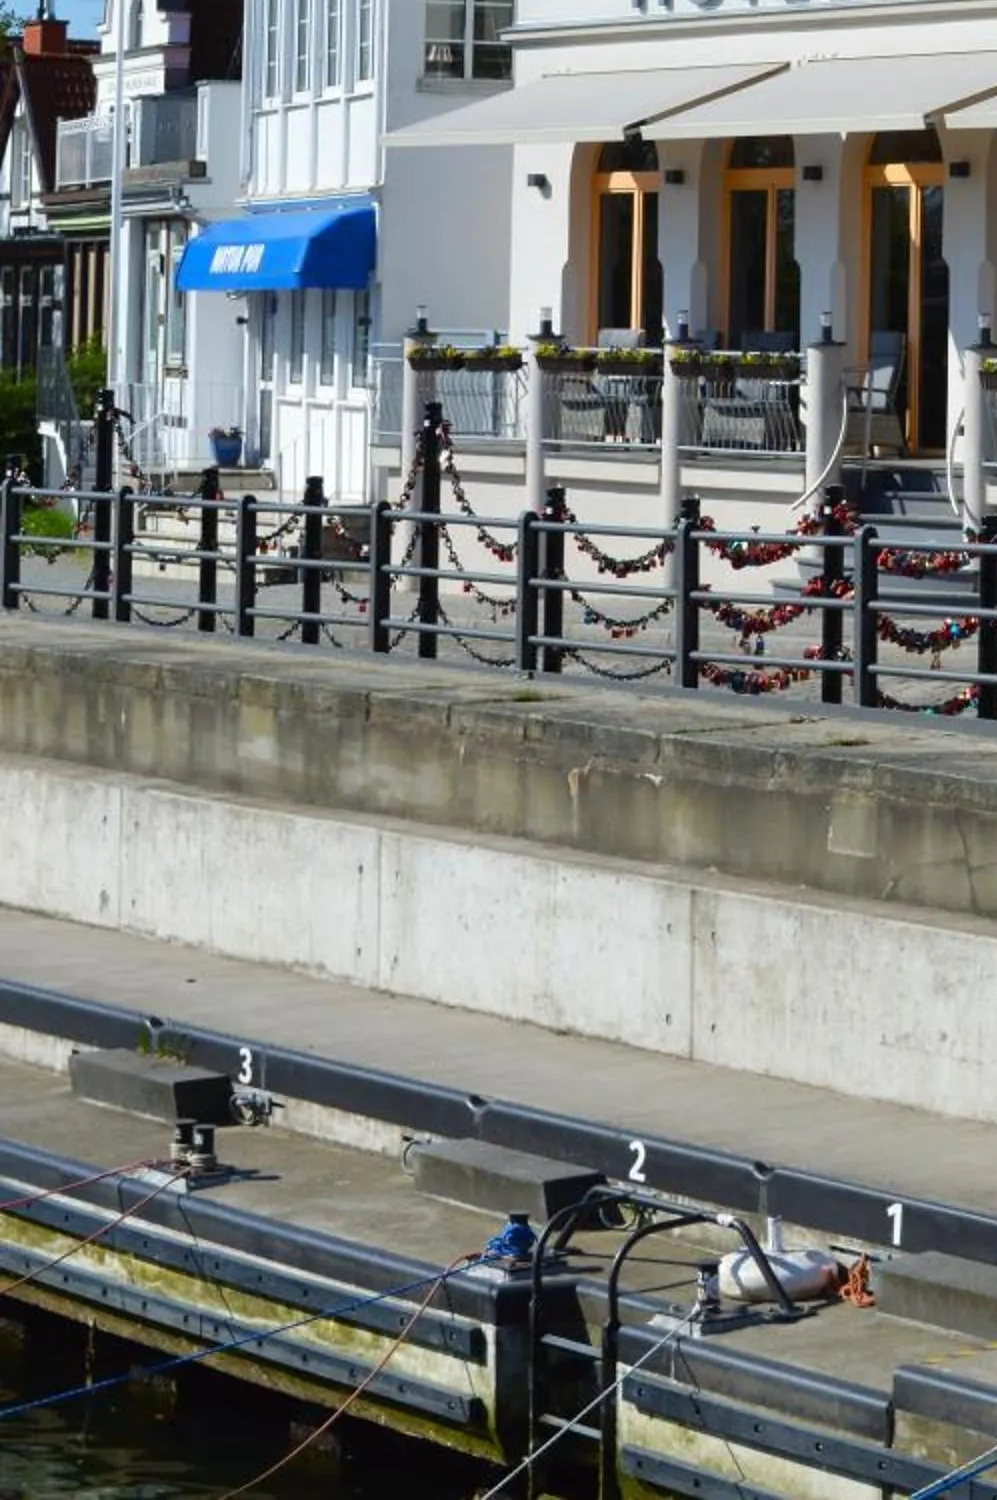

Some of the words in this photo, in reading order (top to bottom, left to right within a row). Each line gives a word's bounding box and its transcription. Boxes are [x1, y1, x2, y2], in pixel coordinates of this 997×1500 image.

[238, 1047, 252, 1084] 3
[629, 1140, 646, 1182] 2
[886, 1203, 902, 1247] 1
